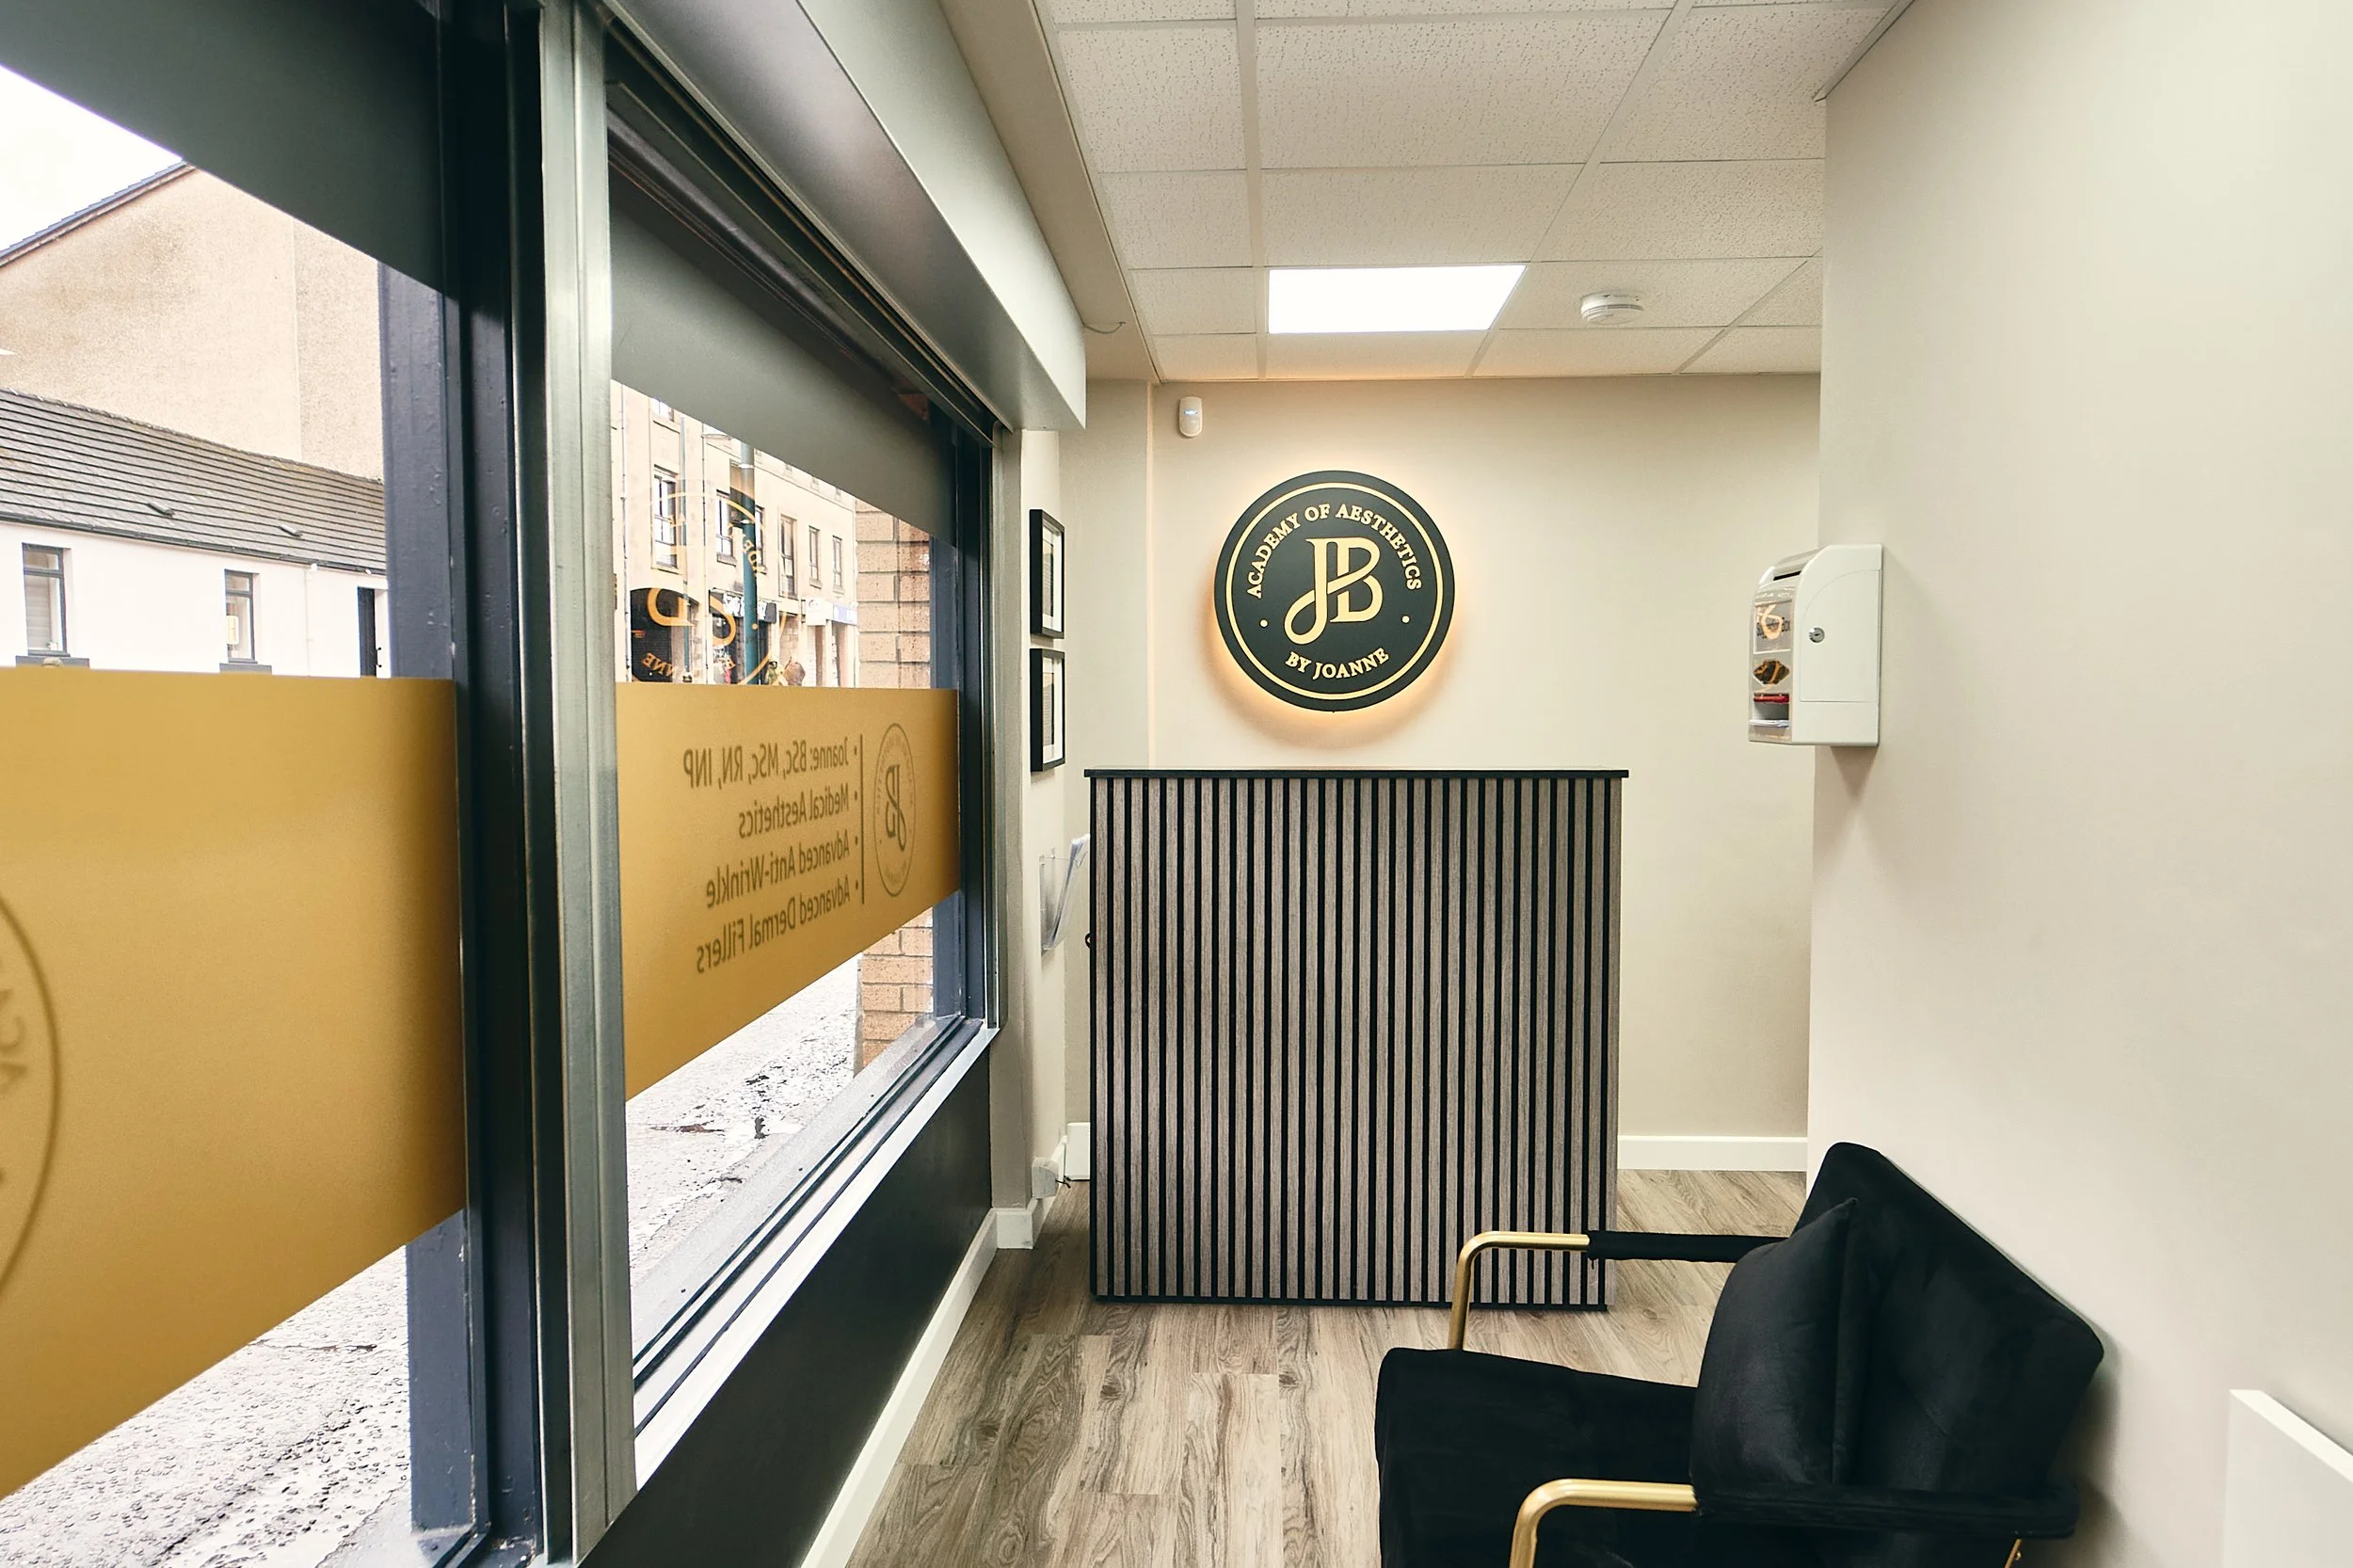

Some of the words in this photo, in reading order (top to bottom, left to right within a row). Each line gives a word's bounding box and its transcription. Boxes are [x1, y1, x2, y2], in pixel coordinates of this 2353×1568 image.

[1247, 512, 1301, 599] ACADEMY
[1305, 504, 1331, 522] OF
[1336, 504, 1422, 590] AESTHETICS
[1285, 651, 1312, 673] BY
[1313, 648, 1389, 680] JOANNE
